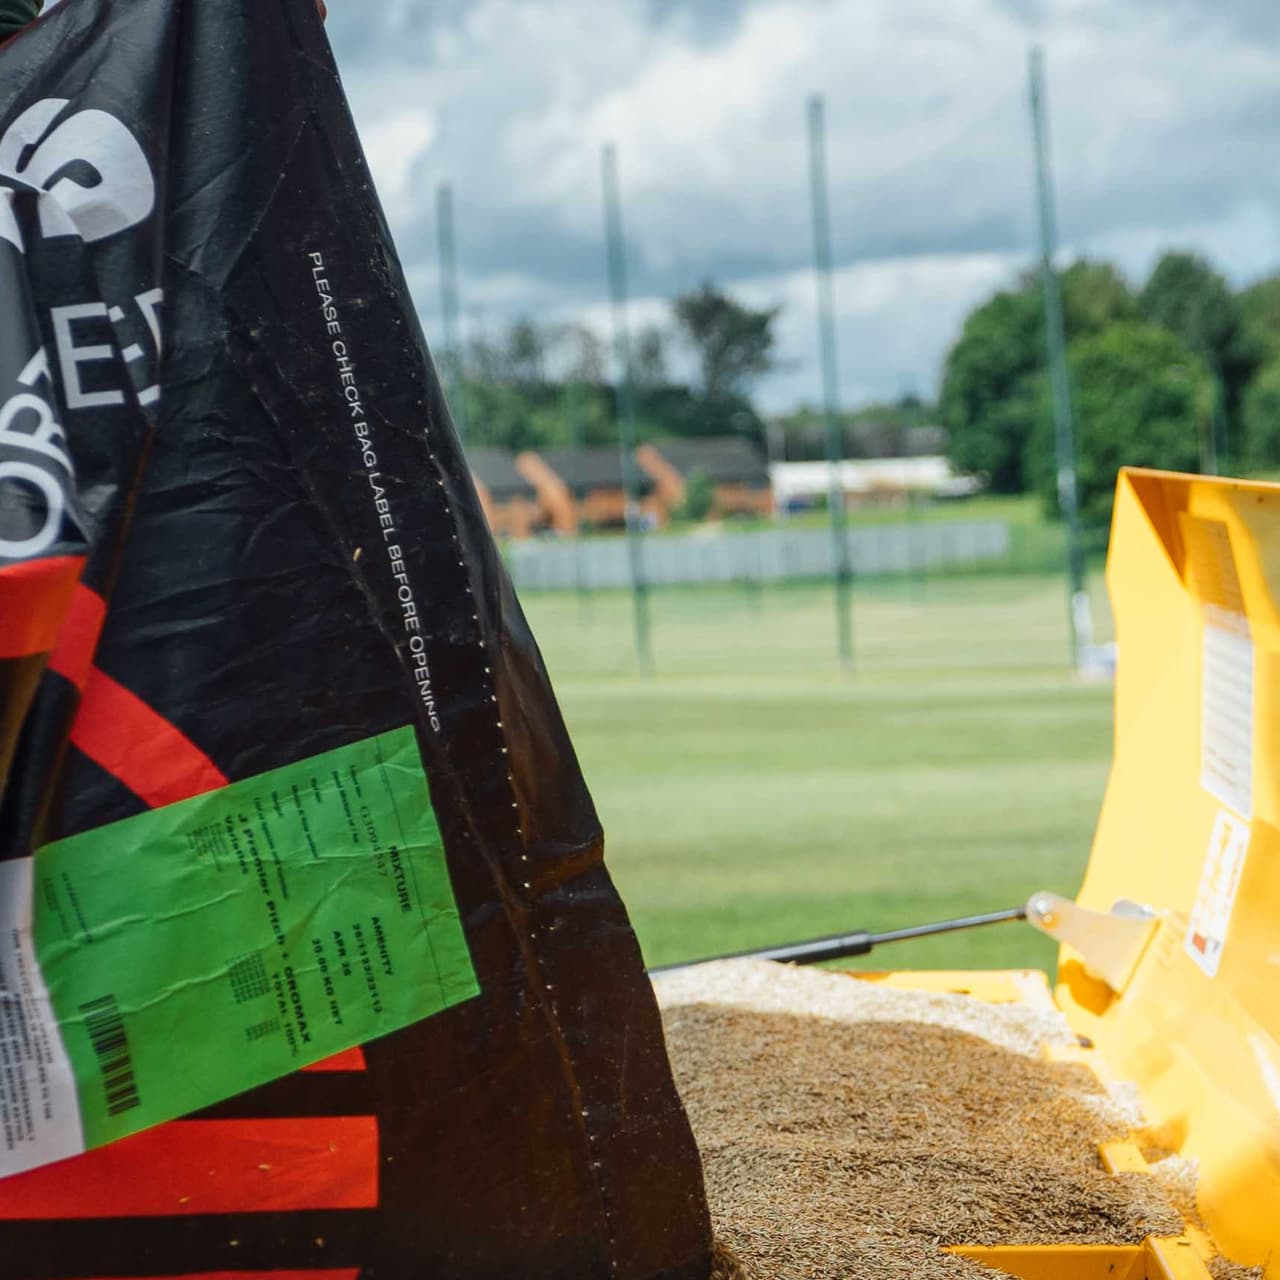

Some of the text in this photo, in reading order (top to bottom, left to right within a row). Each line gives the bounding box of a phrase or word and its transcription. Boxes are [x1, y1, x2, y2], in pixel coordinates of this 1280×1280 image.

[310, 251, 441, 732] PLEASE CHECK BAG LABEL BEFORE OPENING
[387, 846, 412, 913] MIXTURE
[264, 899, 287, 946] Pitch
[282, 965, 312, 1044] GROMAX
[331, 930, 346, 957] APR
[370, 915, 394, 978] AMENITY
[270, 972, 289, 1016] TOTAL
